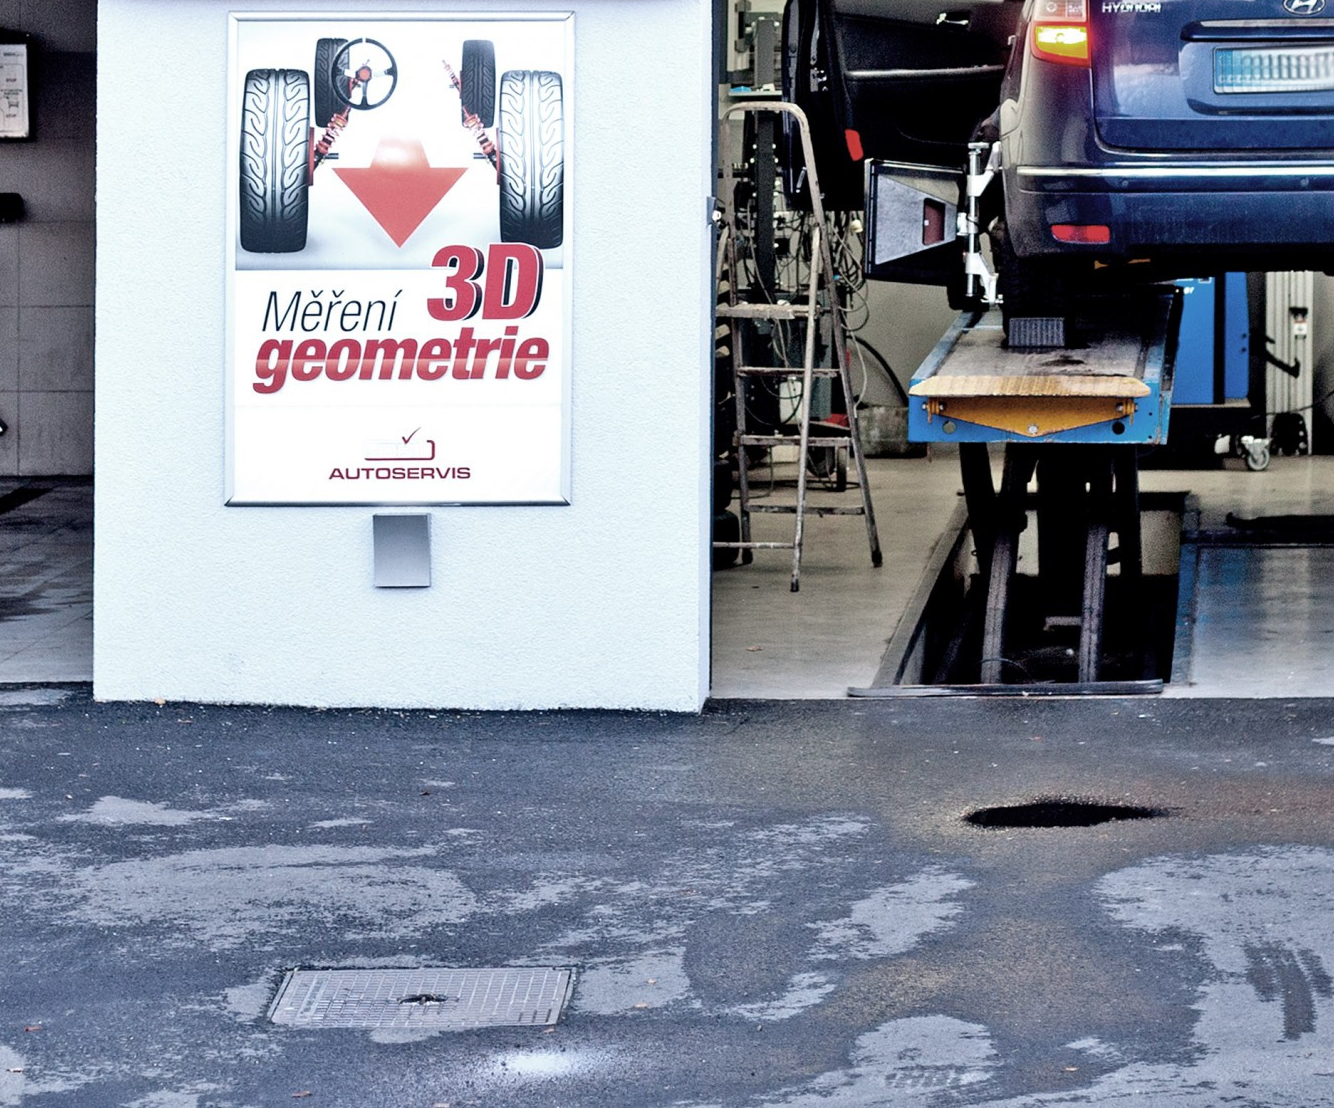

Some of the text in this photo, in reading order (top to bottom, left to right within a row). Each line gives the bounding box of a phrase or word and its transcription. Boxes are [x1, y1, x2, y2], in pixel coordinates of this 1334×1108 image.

[1102, 1, 1162, 13] HYUNDAI
[262, 243, 546, 333] Měření 3D
[252, 325, 550, 395] geometrie
[328, 466, 472, 480] AUTOSERVIS
